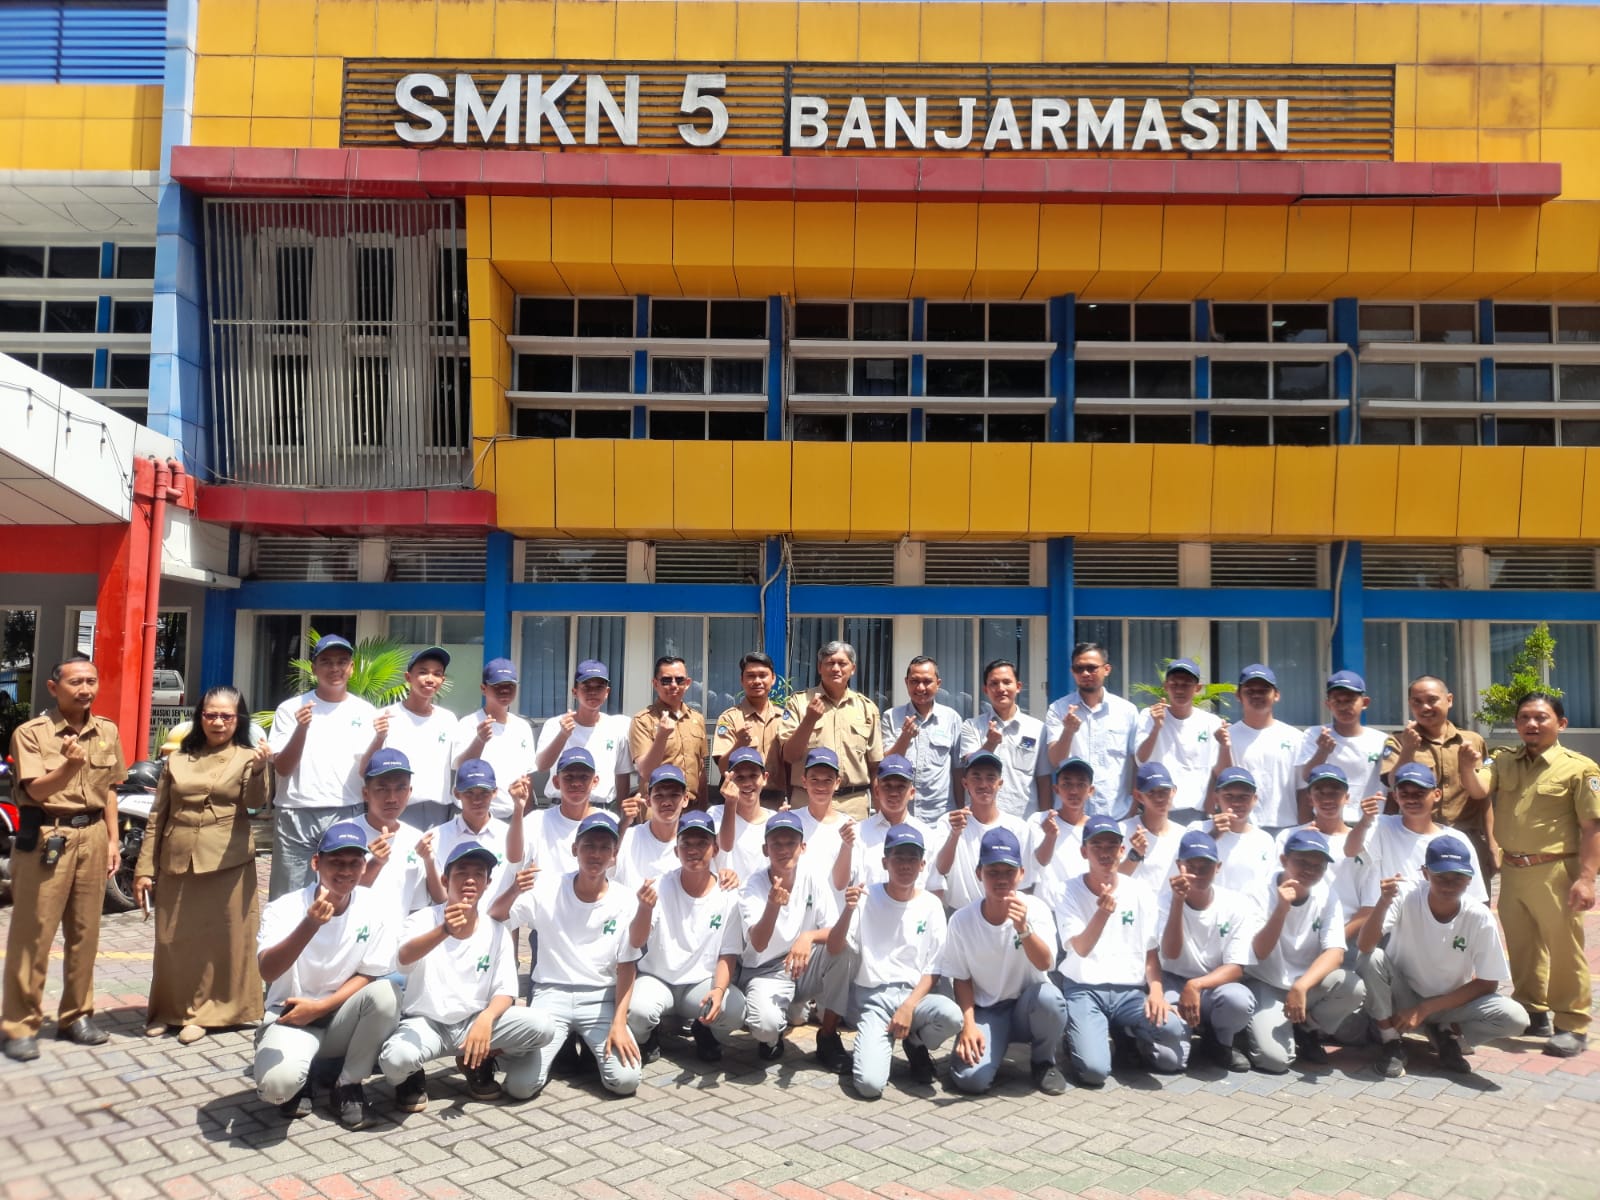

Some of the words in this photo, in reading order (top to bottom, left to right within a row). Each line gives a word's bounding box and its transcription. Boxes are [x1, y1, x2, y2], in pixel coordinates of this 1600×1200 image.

[394, 73, 639, 146] SMKN
[677, 74, 729, 147] 5
[789, 96, 1289, 152] BANJARMASIN
